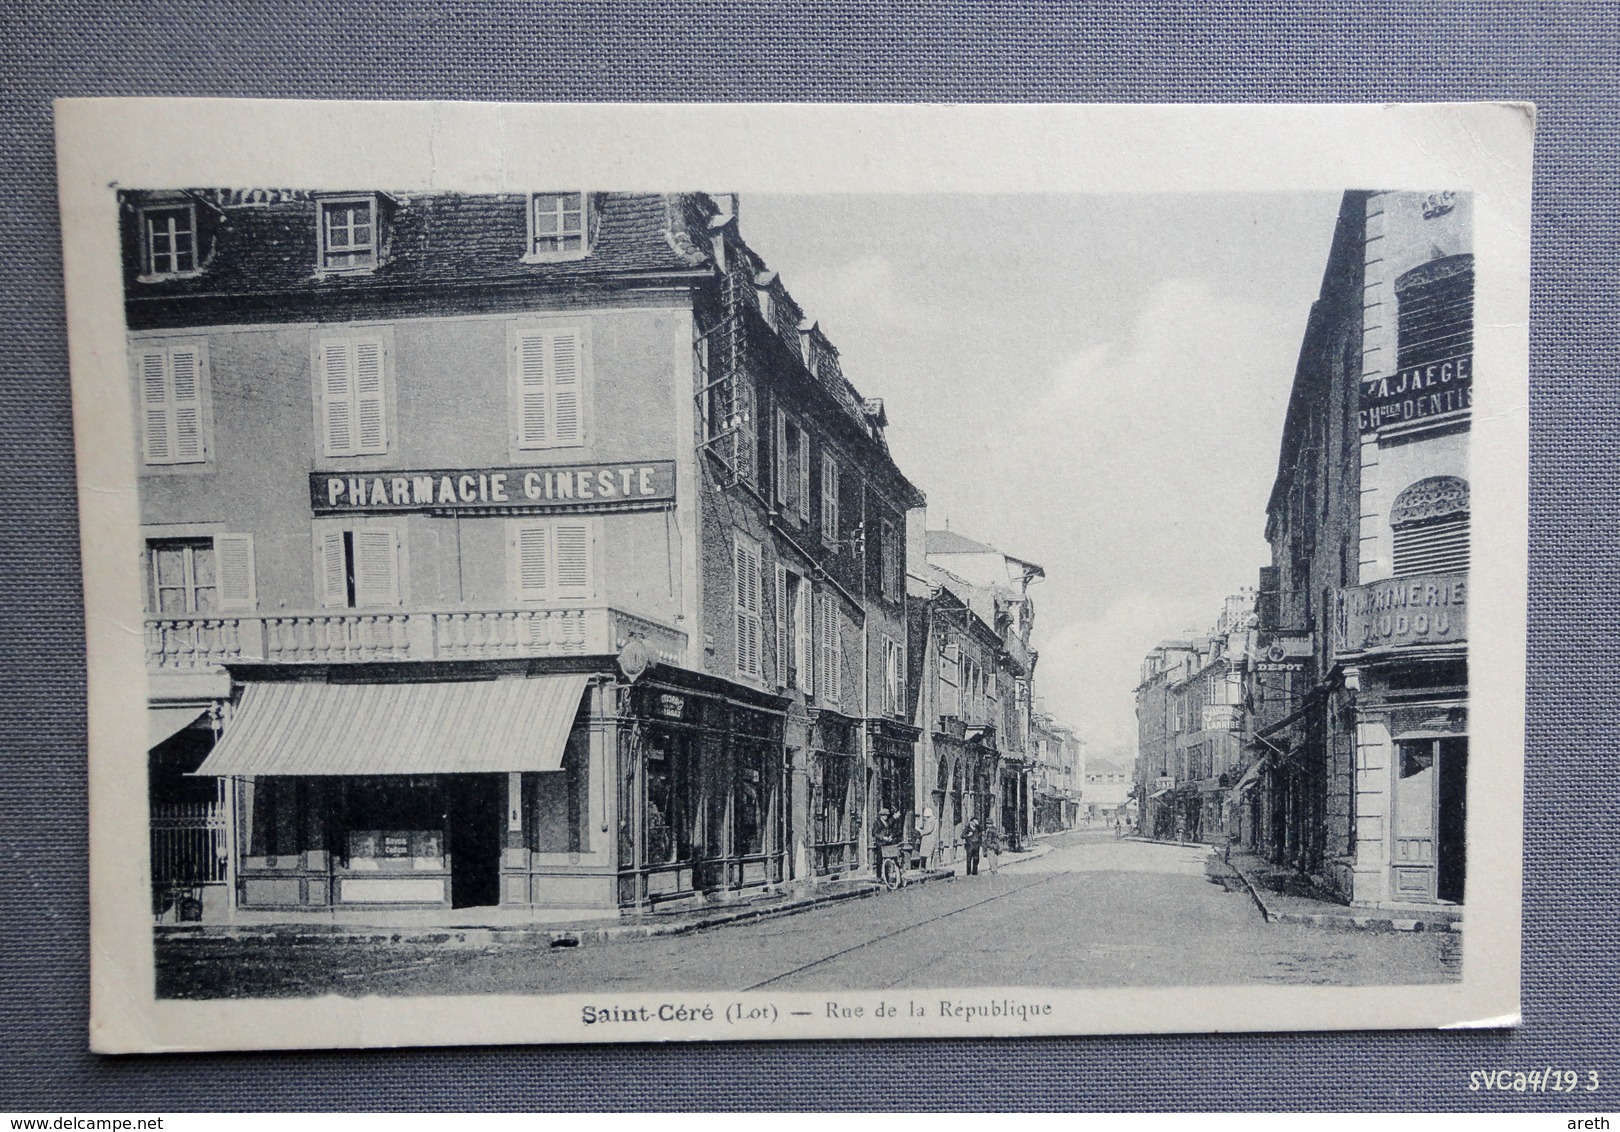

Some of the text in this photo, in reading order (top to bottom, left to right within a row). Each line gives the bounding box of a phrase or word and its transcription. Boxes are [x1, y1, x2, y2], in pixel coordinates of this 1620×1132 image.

[327, 467, 656, 506] PHARMACIE GINESTE
[1206, 720, 1240, 729] LARRIBE
[582, 1004, 714, 1025] Saint-Céré
[726, 1003, 779, 1022] (Lot)
[825, 1001, 864, 1019] Rue
[875, 1002, 898, 1018] de
[909, 1001, 926, 1018] la
[940, 999, 1053, 1021] République
